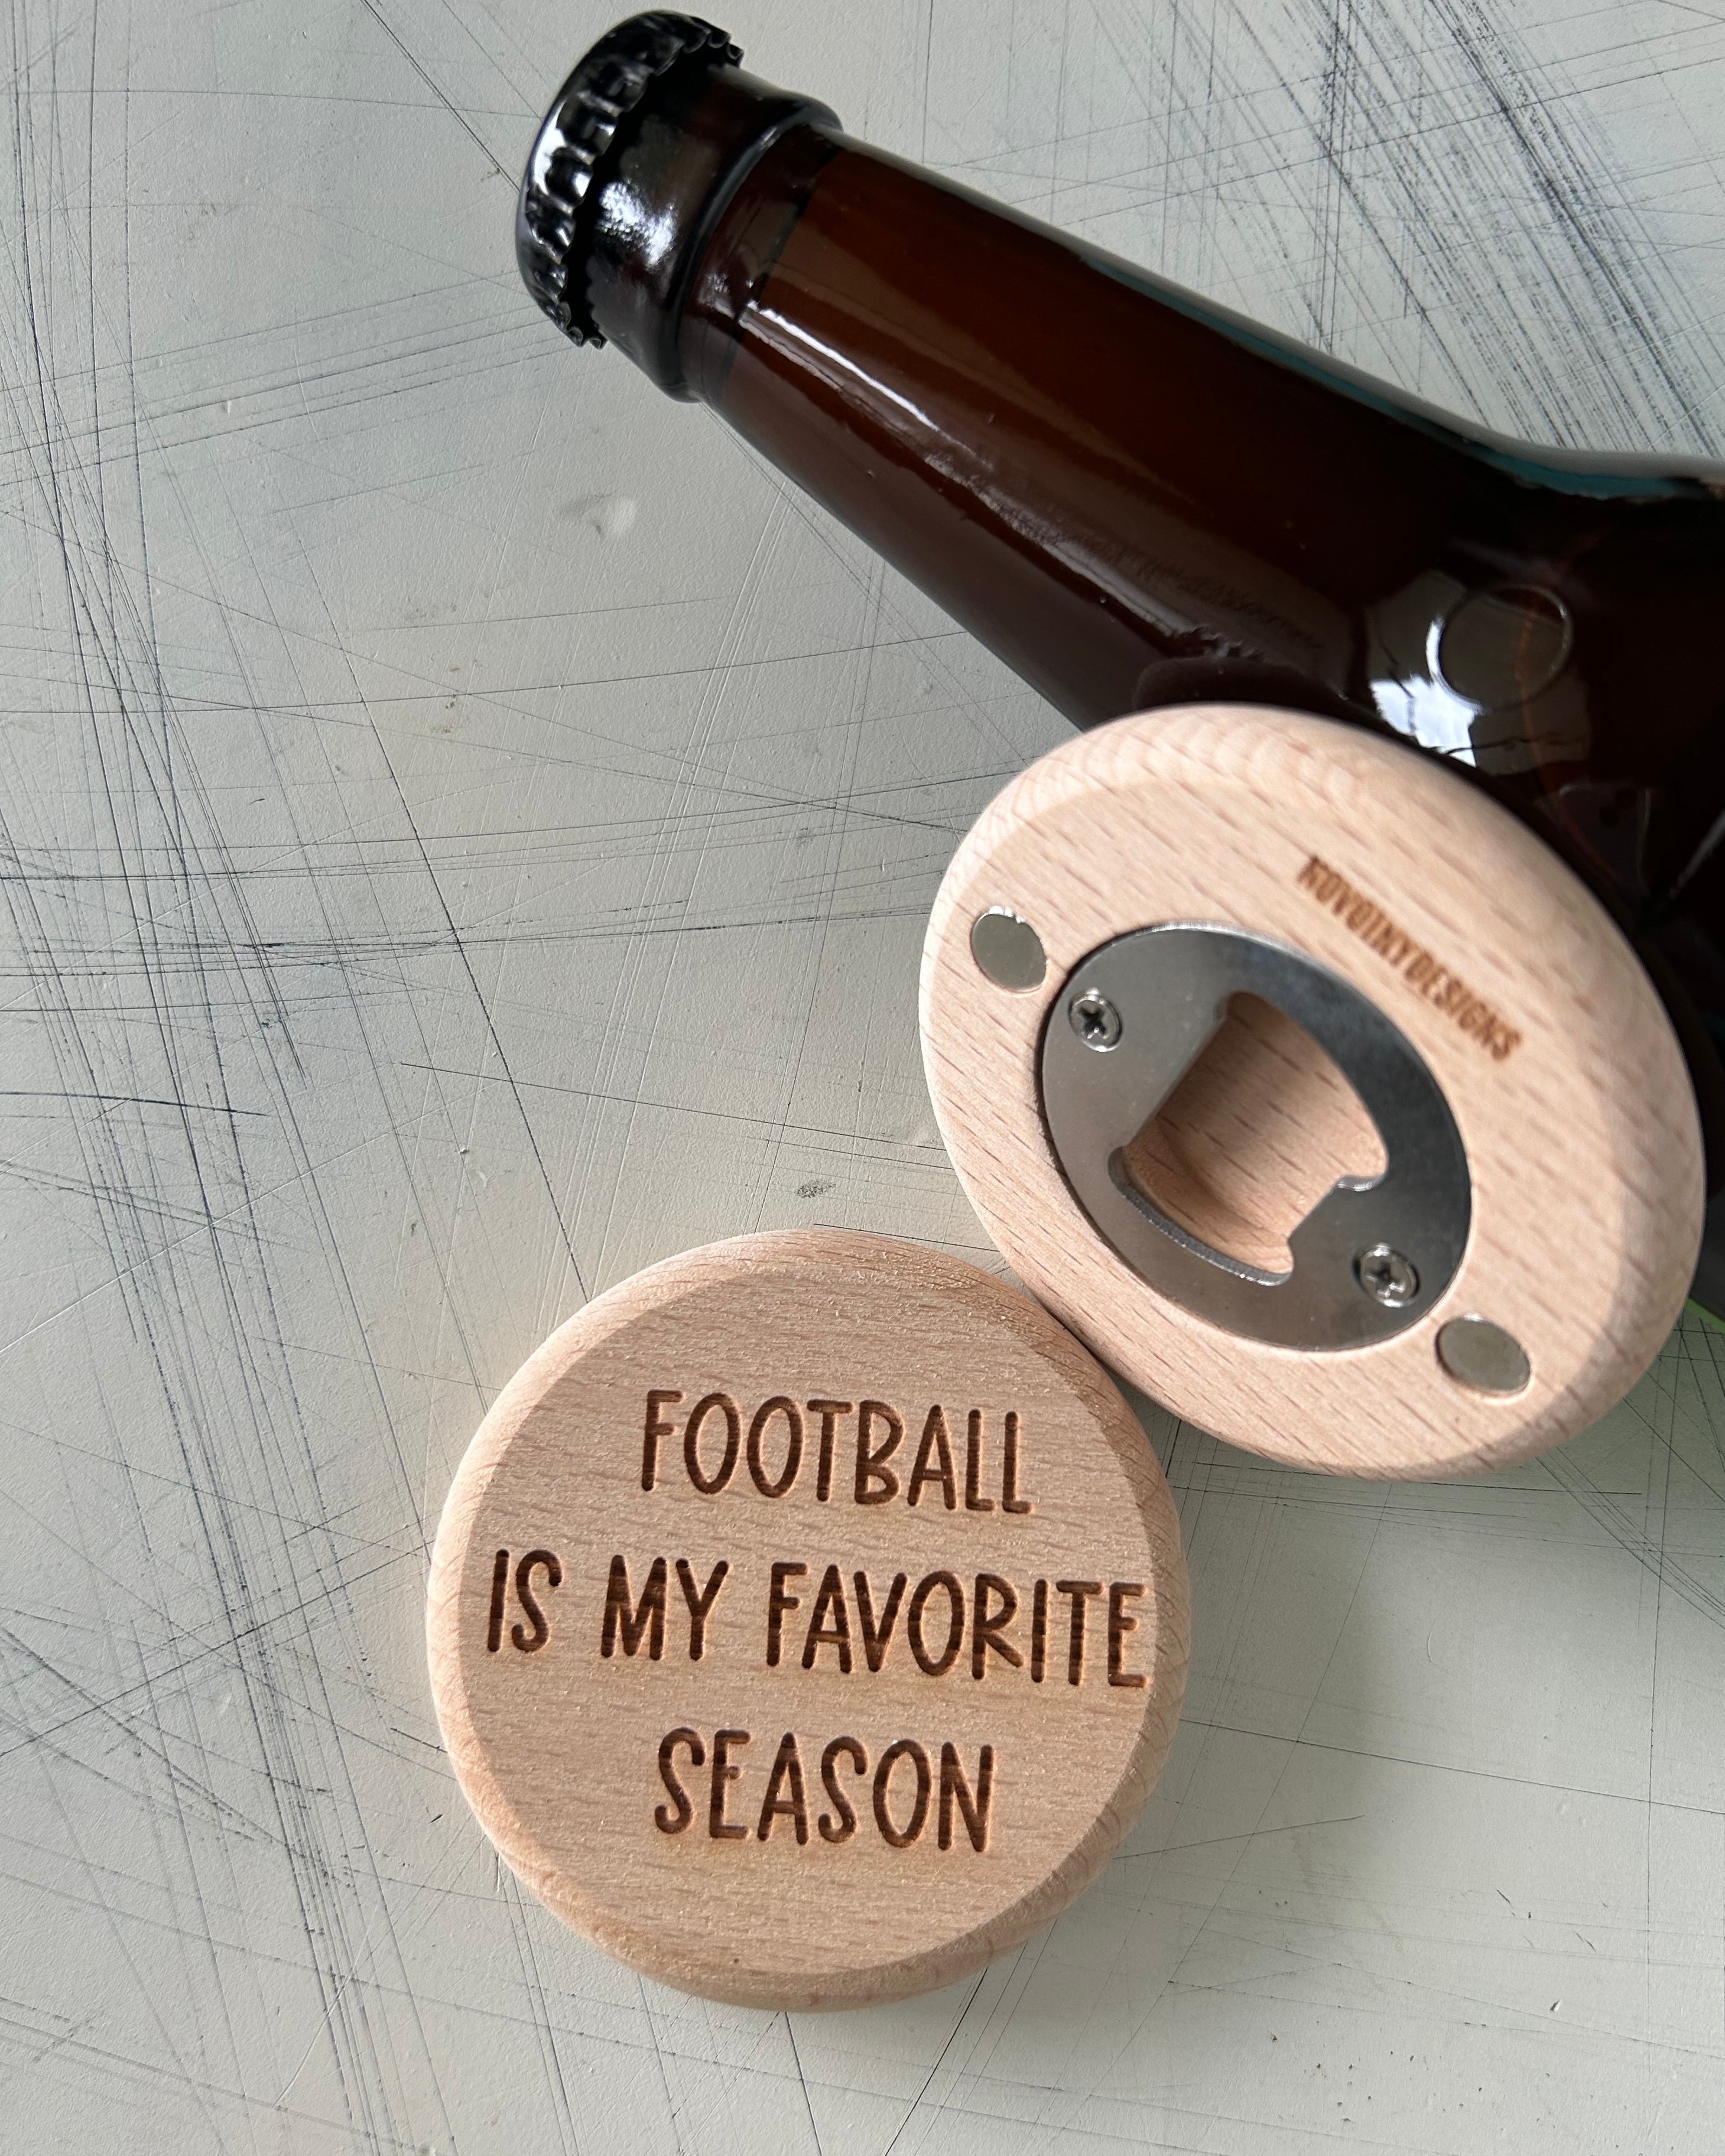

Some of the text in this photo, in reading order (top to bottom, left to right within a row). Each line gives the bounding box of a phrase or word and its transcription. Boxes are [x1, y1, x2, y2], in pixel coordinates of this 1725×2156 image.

[641, 1389, 1034, 1514] FOOTBALL
[487, 1549, 1146, 1688] IS MY FAVORITE
[654, 1726, 994, 1853] SEASON
